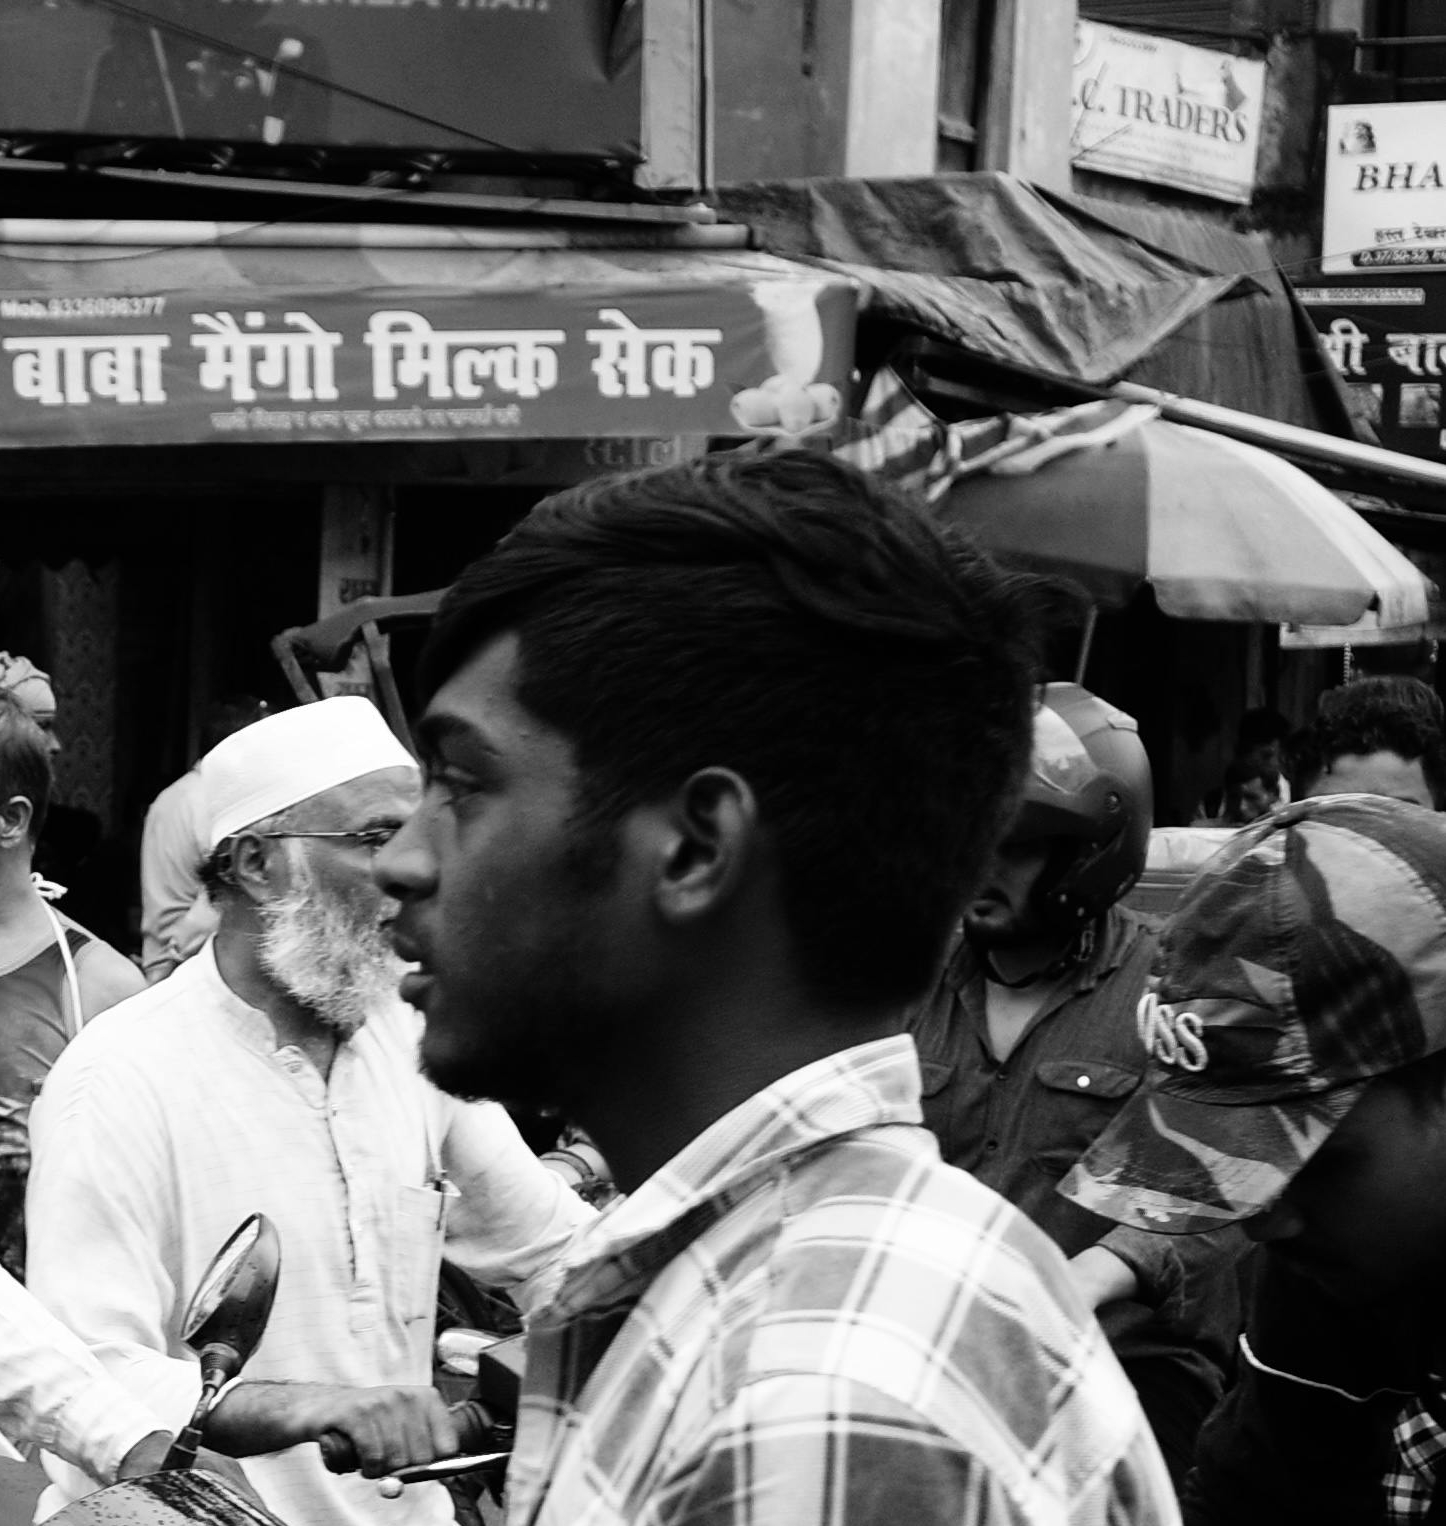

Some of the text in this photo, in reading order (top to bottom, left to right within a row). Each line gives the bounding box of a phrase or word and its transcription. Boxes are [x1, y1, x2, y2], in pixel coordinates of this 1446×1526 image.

[1113, 82, 1249, 145] TRADERS
[2, 307, 724, 405] बाबा मैंगो मिल्क सेक
